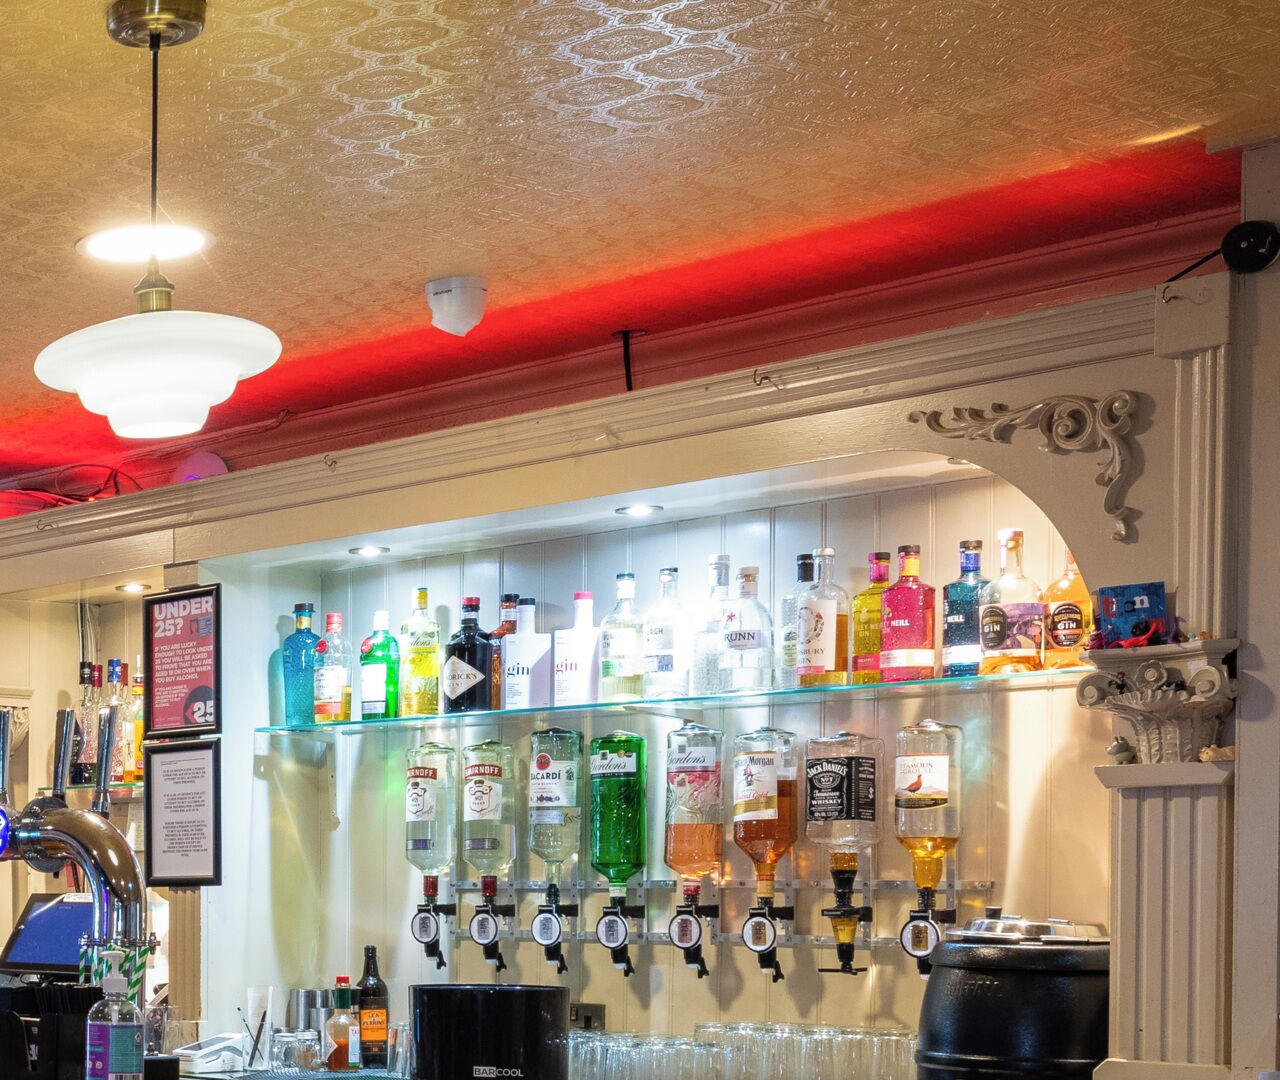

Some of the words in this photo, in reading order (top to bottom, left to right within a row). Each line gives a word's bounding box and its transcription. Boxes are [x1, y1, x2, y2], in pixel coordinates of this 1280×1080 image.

[154, 596, 213, 620] UNDER
[891, 619, 910, 627] NEILL
[947, 615, 965, 623] NEILL
[155, 618, 183, 638] 25?
[984, 624, 1000, 633] GIN
[1057, 622, 1077, 630] GIN
[180, 641, 197, 649] LUCKY
[183, 647, 196, 655] LOOK
[191, 652, 208, 660] ASKED
[507, 662, 530, 678] gin
[555, 658, 578, 673] gin
[176, 673, 200, 681] ALCOHOL
[193, 700, 214, 723] 25
[749, 756, 775, 767] Morgan
[807, 764, 822, 778] JACK
[823, 761, 848, 776] DANIEL'S
[473, 1066, 525, 1078] BARCOOL
